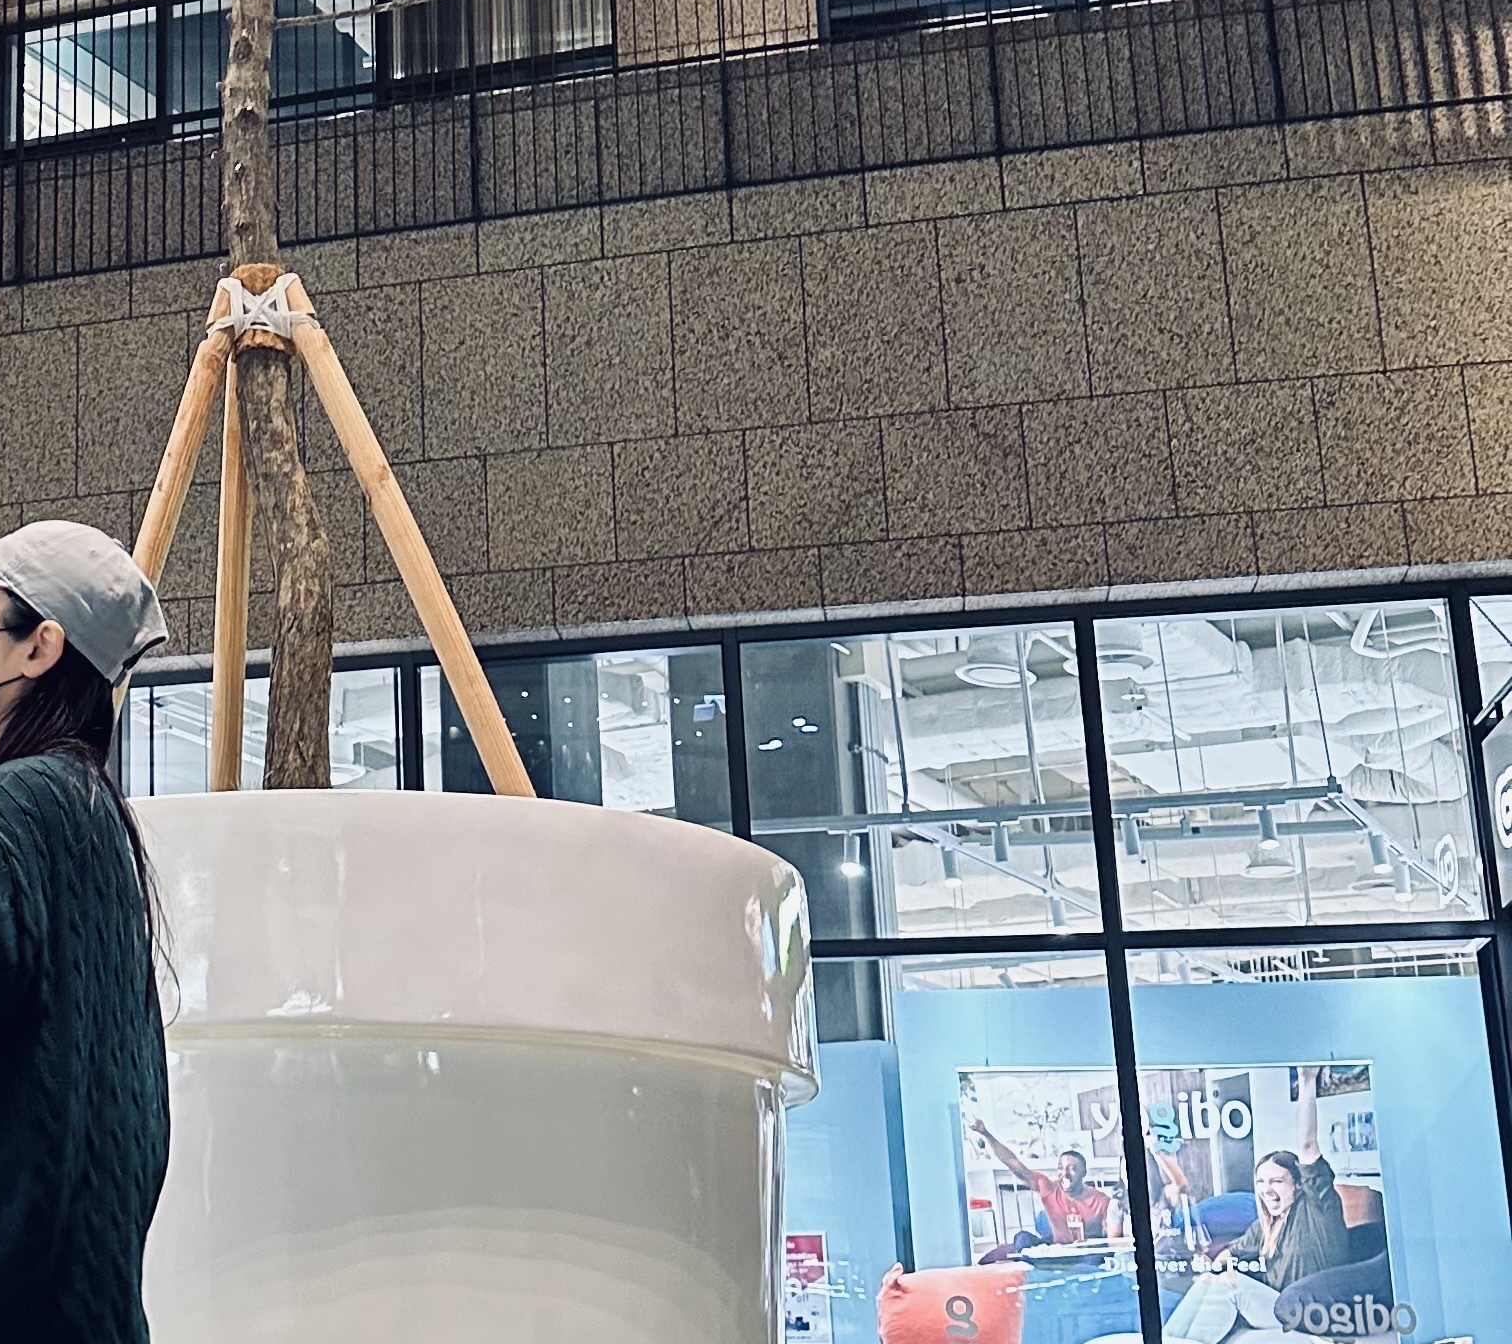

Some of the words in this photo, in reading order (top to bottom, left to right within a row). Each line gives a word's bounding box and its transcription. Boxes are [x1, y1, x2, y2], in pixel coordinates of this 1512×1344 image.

[1090, 1091, 1252, 1153] ygibo
[1103, 1257, 1188, 1273] Disver
[1192, 1255, 1222, 1272] the
[1226, 1257, 1267, 1272] Feel
[1281, 1294, 1417, 1344] yogibo
